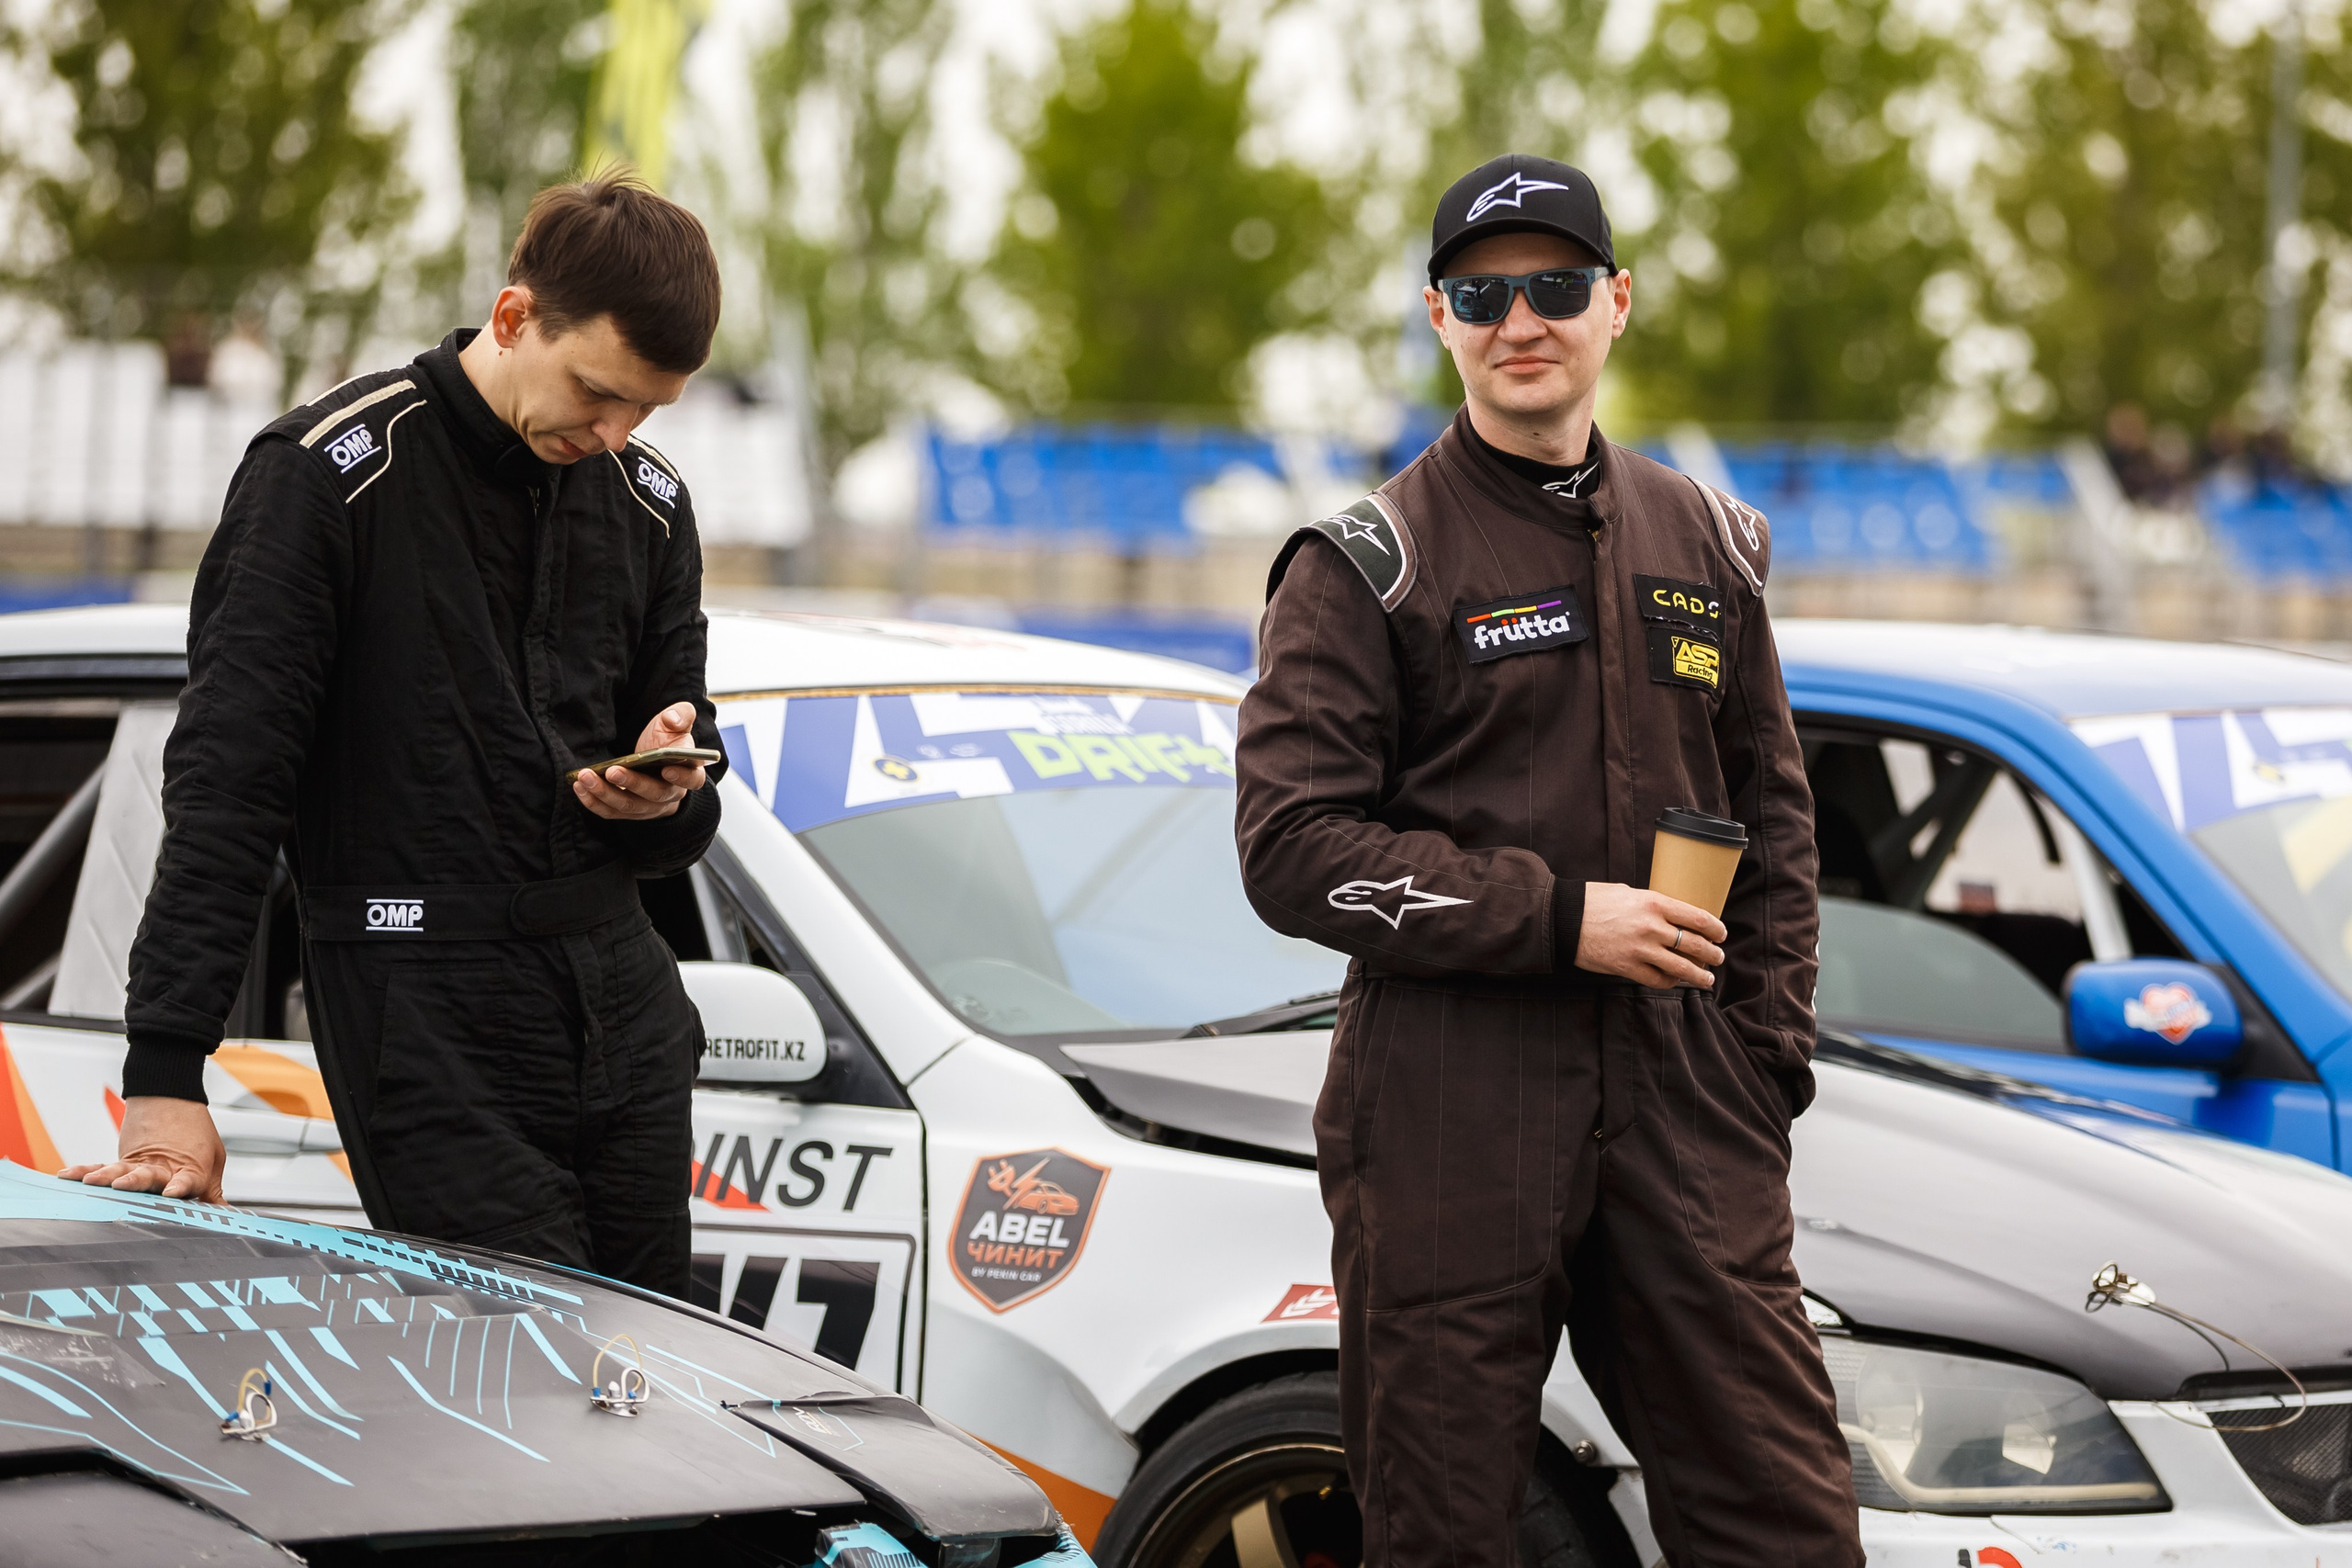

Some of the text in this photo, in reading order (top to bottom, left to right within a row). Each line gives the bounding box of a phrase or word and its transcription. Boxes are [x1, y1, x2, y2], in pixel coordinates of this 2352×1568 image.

[332, 429, 373, 466] OMP
[638, 463, 677, 499] OMP
[1474, 614, 1570, 649] frütta
[1687, 664, 1713, 681] Racing
[368, 904, 424, 927] OMP
[692, 1134, 893, 1212] INST
[969, 1211, 1069, 1247] ABEL
[967, 1241, 1065, 1269] ЧИНИТ
